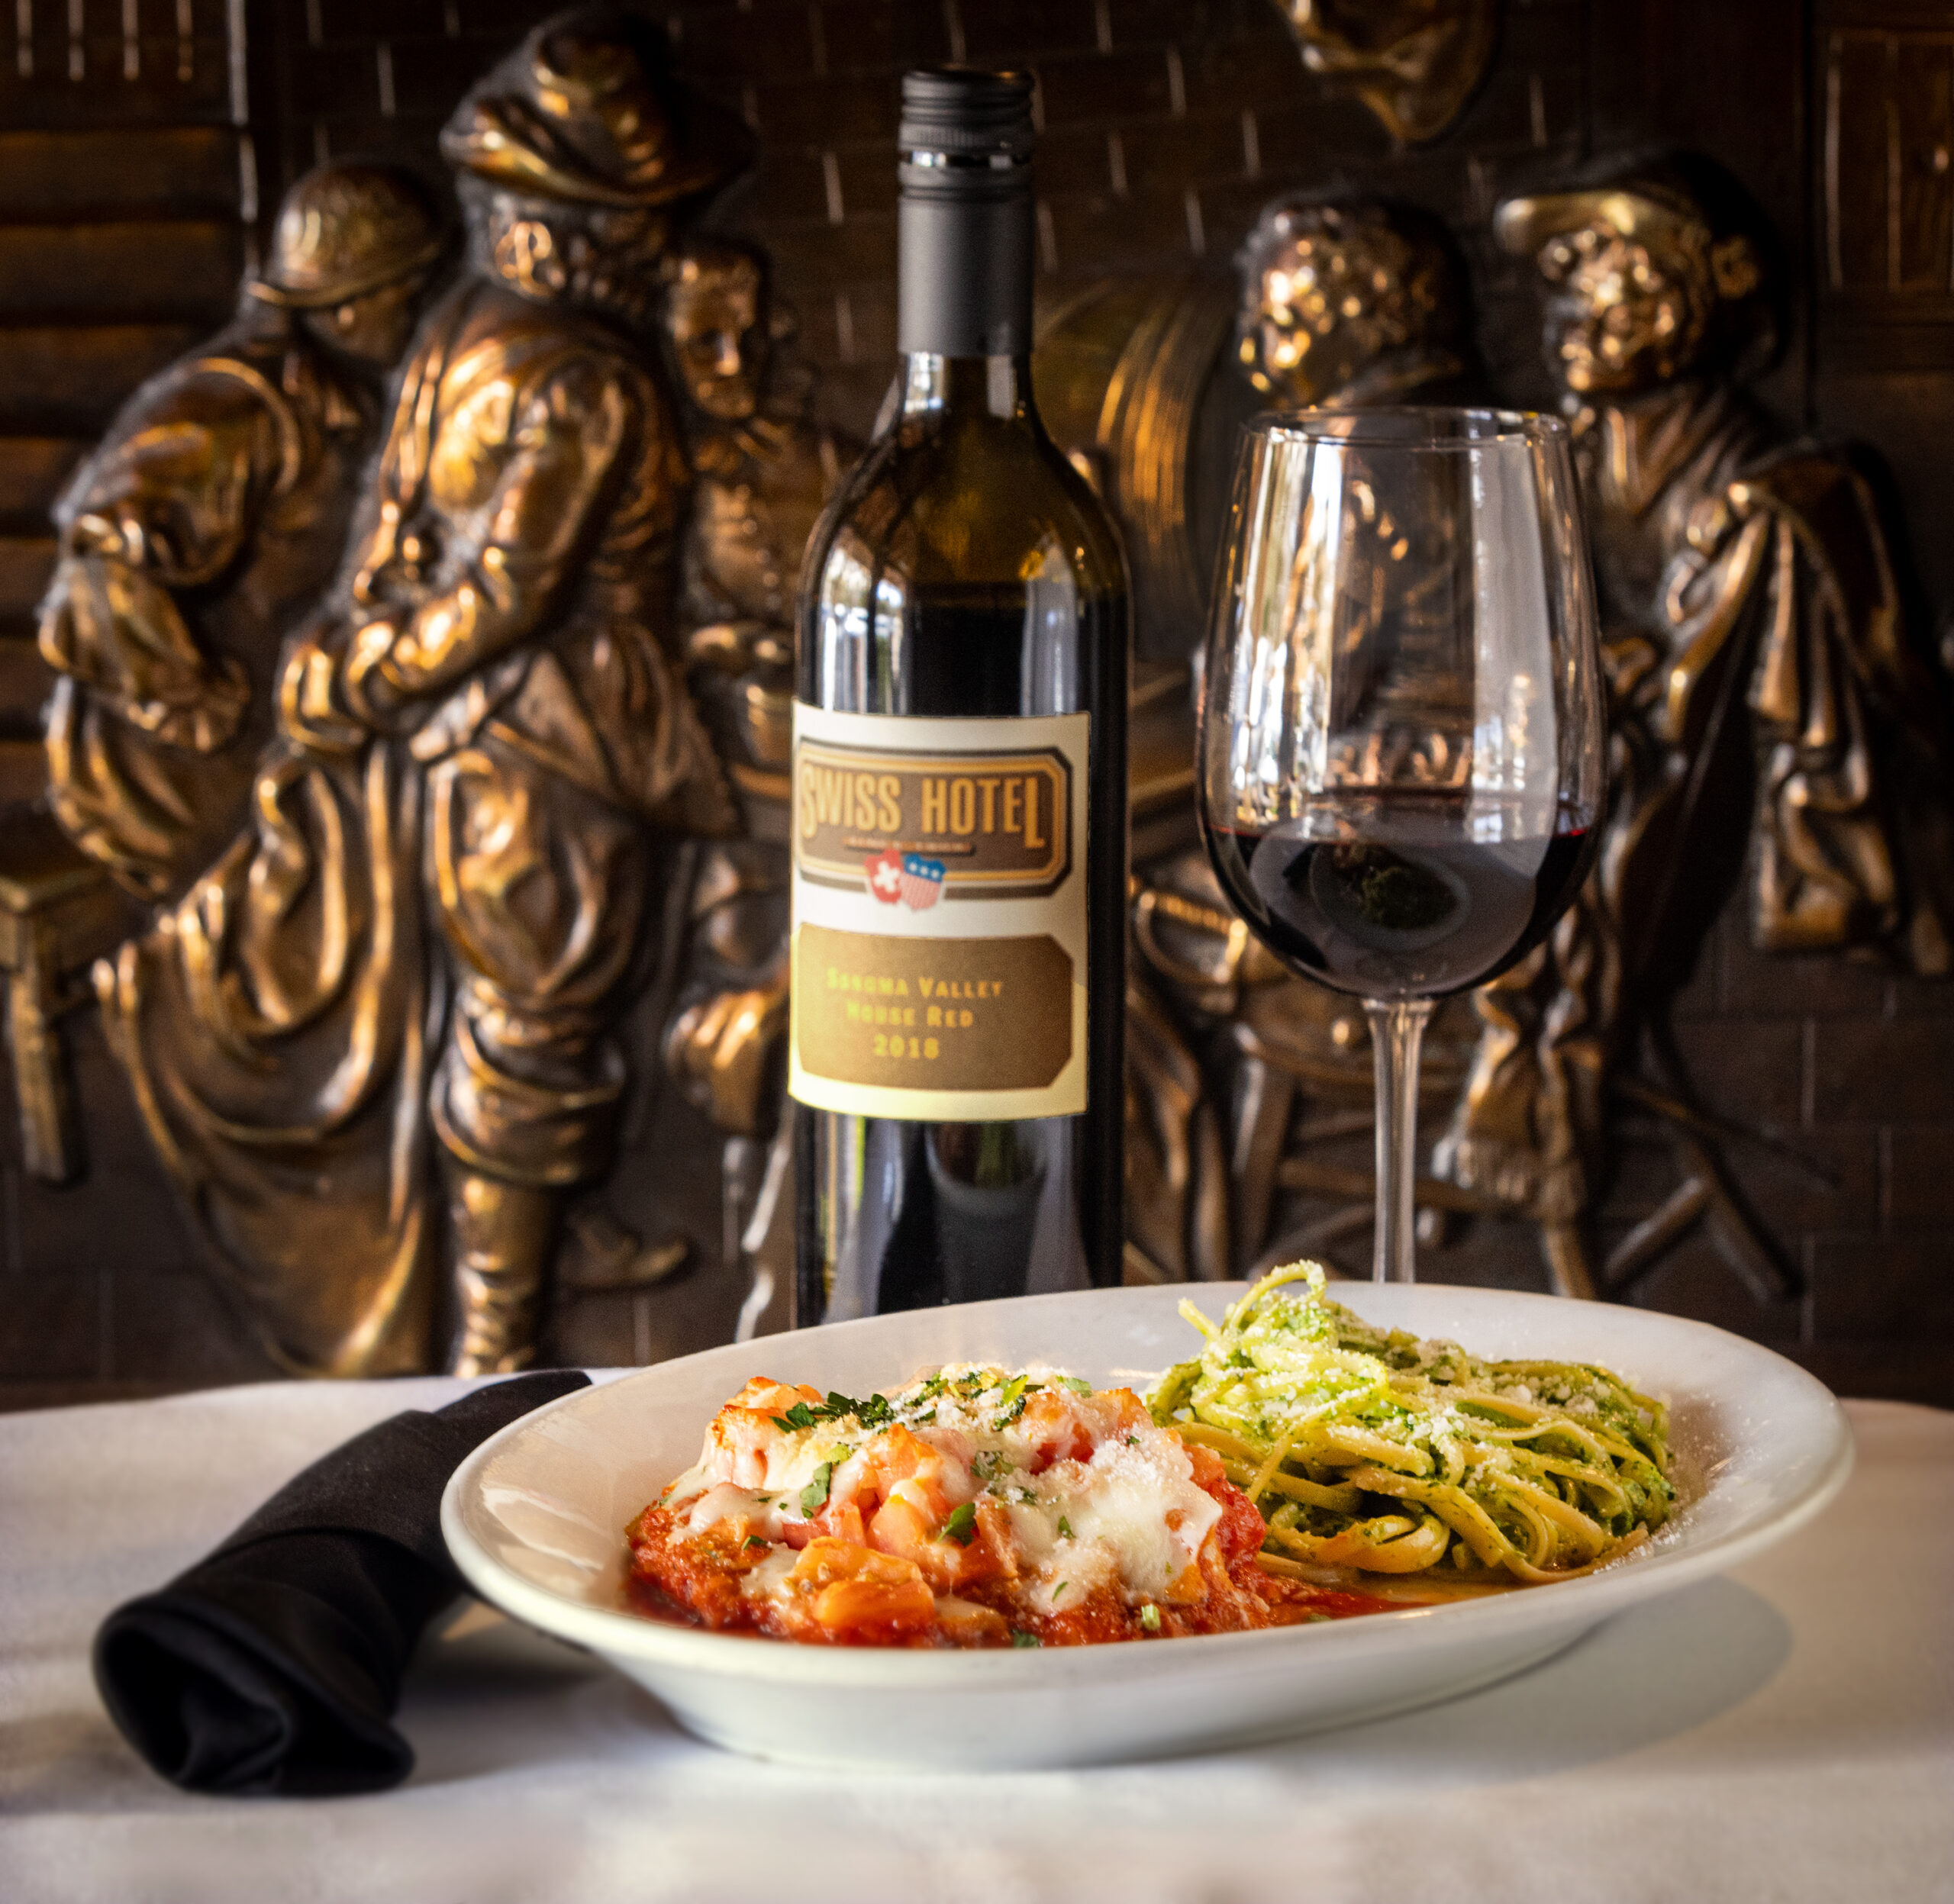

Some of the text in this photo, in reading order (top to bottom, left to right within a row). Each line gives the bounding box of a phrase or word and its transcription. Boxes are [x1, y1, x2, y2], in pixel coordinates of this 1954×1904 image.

[800, 765, 1044, 848] SWISS HOTEL
[919, 976, 1002, 999] VALLEY
[927, 1005, 973, 1027] RED
[874, 1033, 940, 1059] 2018
